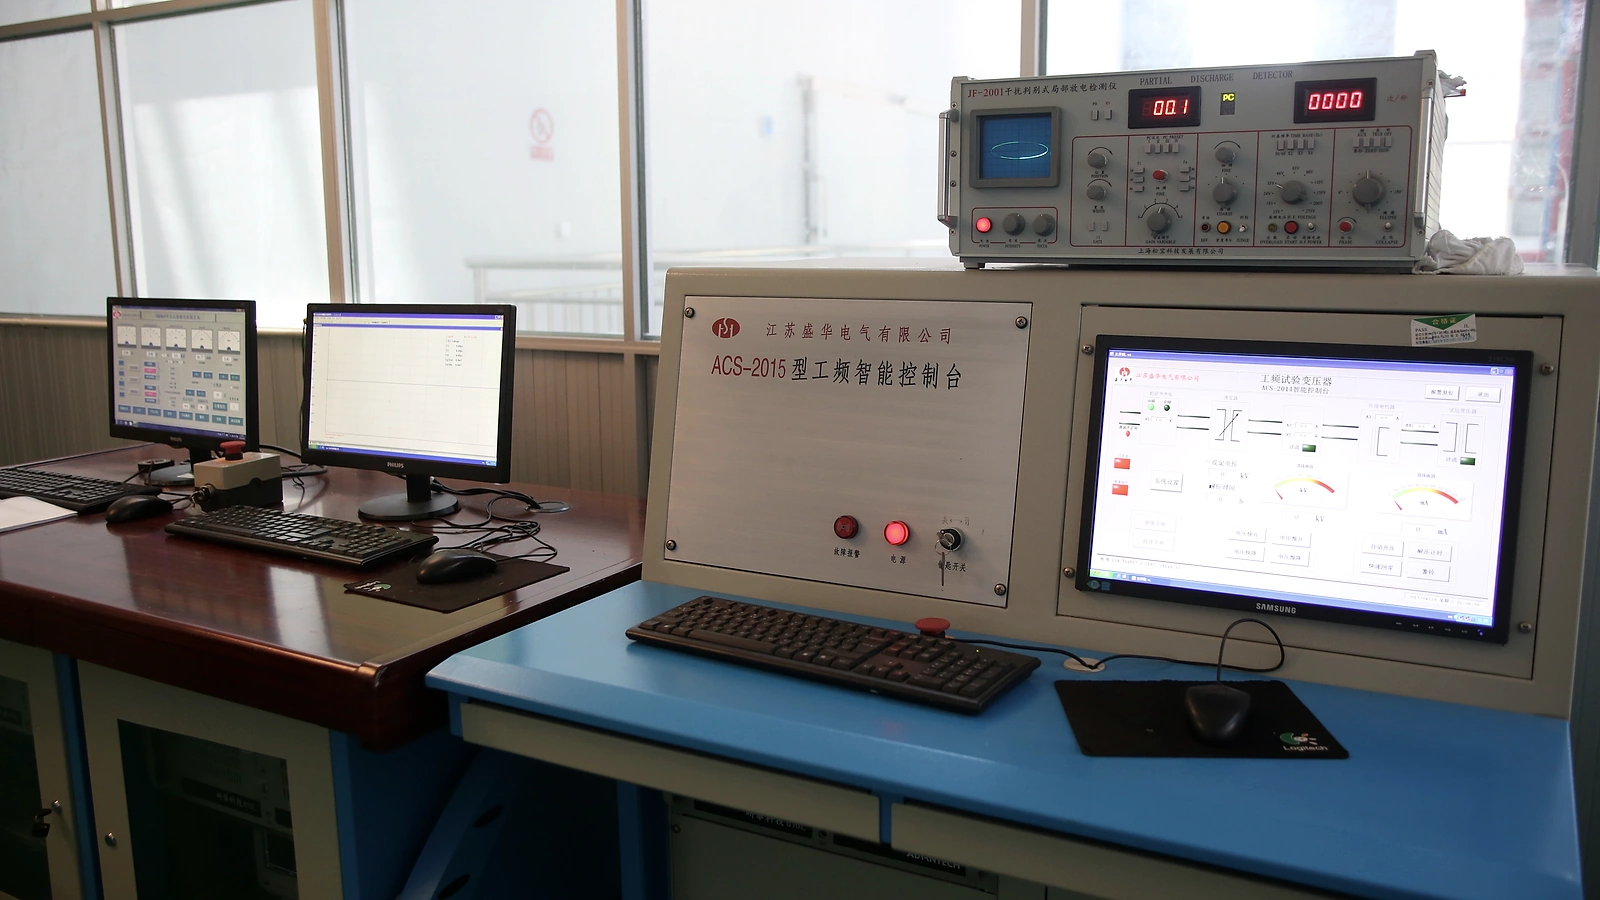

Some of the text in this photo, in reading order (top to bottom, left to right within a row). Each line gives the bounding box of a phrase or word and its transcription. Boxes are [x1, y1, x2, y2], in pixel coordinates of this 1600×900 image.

[1140, 70, 1293, 86] PARTIAL DISCHARGE DETECTOR
[1222, 94, 1234, 102] PC
[1308, 91, 1362, 110] 0000
[1152, 100, 1188, 116] 00.1
[766, 322, 951, 344] 江苏盛华电气有限公司
[1260, 374, 1332, 386] 工频试验变压器
[890, 554, 907, 565] 电源
[1256, 602, 1296, 614] SAMSUNG
